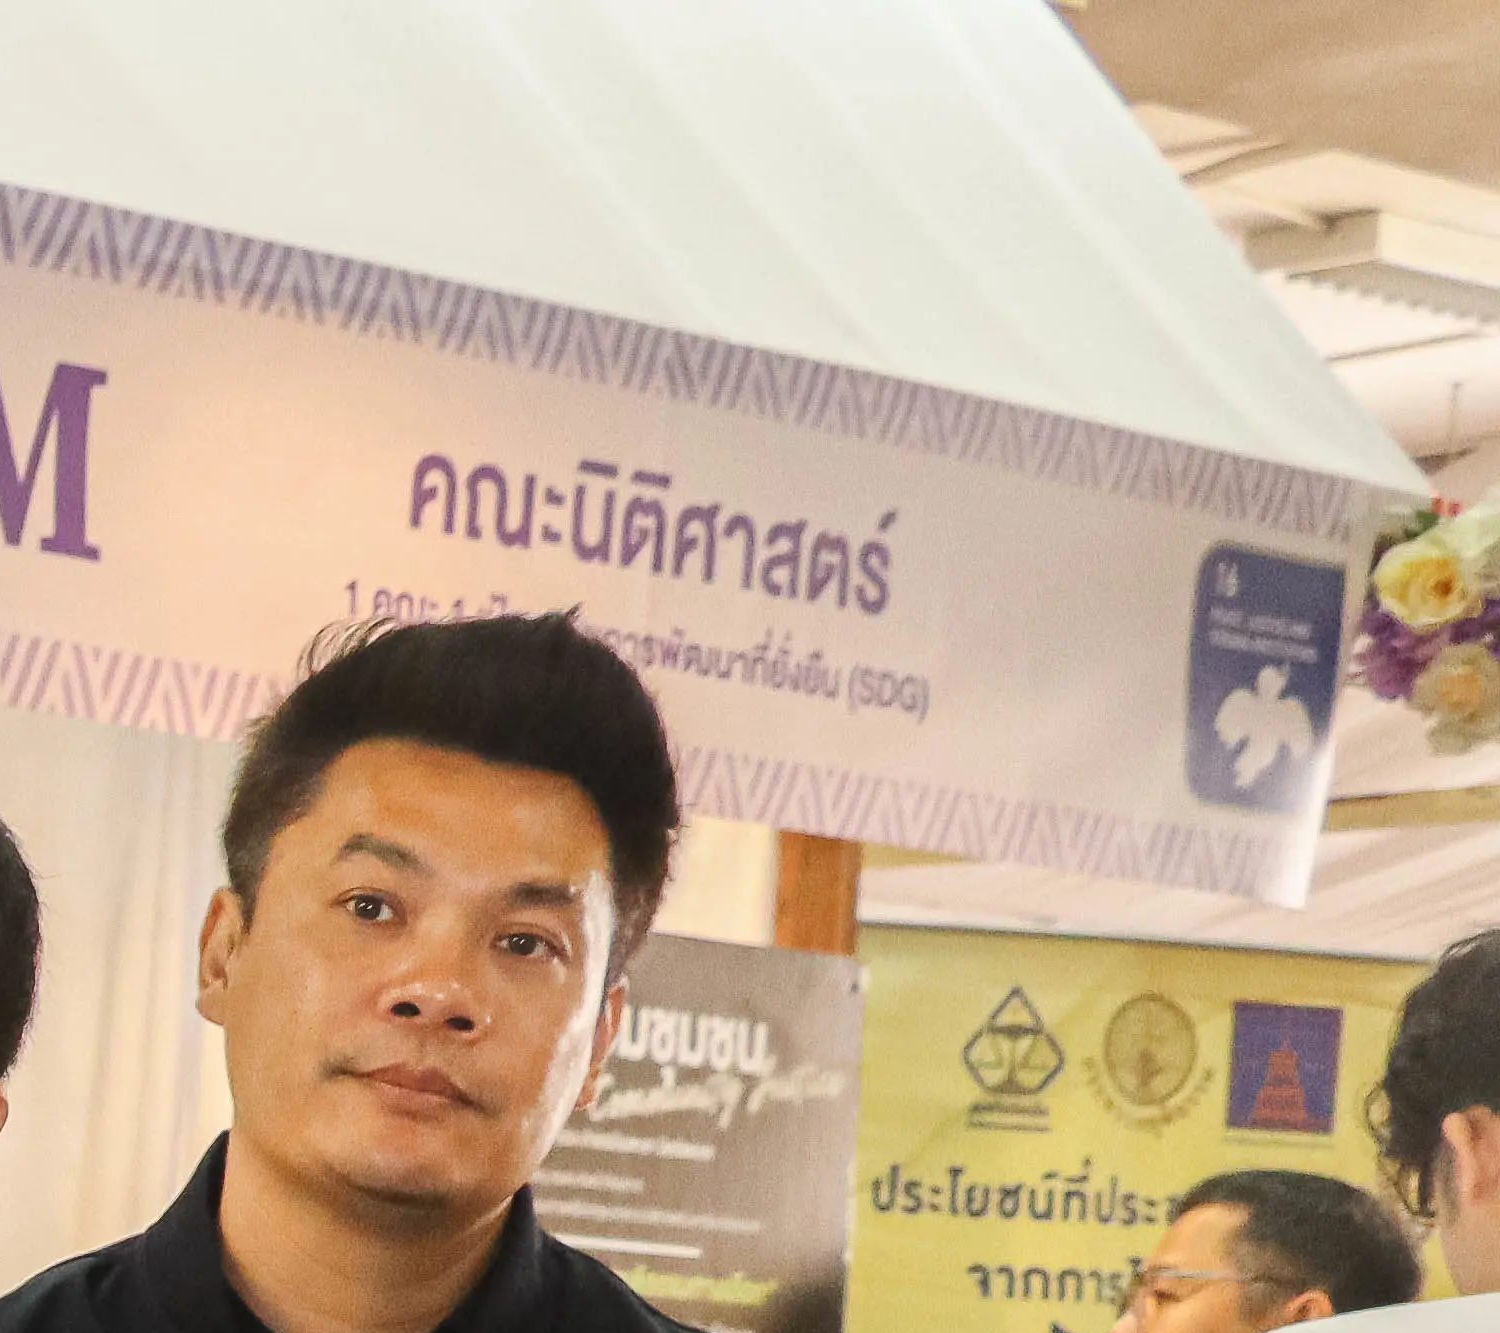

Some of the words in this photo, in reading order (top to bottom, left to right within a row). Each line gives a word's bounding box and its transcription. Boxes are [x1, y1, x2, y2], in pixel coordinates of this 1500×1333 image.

[408, 452, 898, 616] คณะนิติศาสตร์
[848, 662, 930, 726] (SDG)
